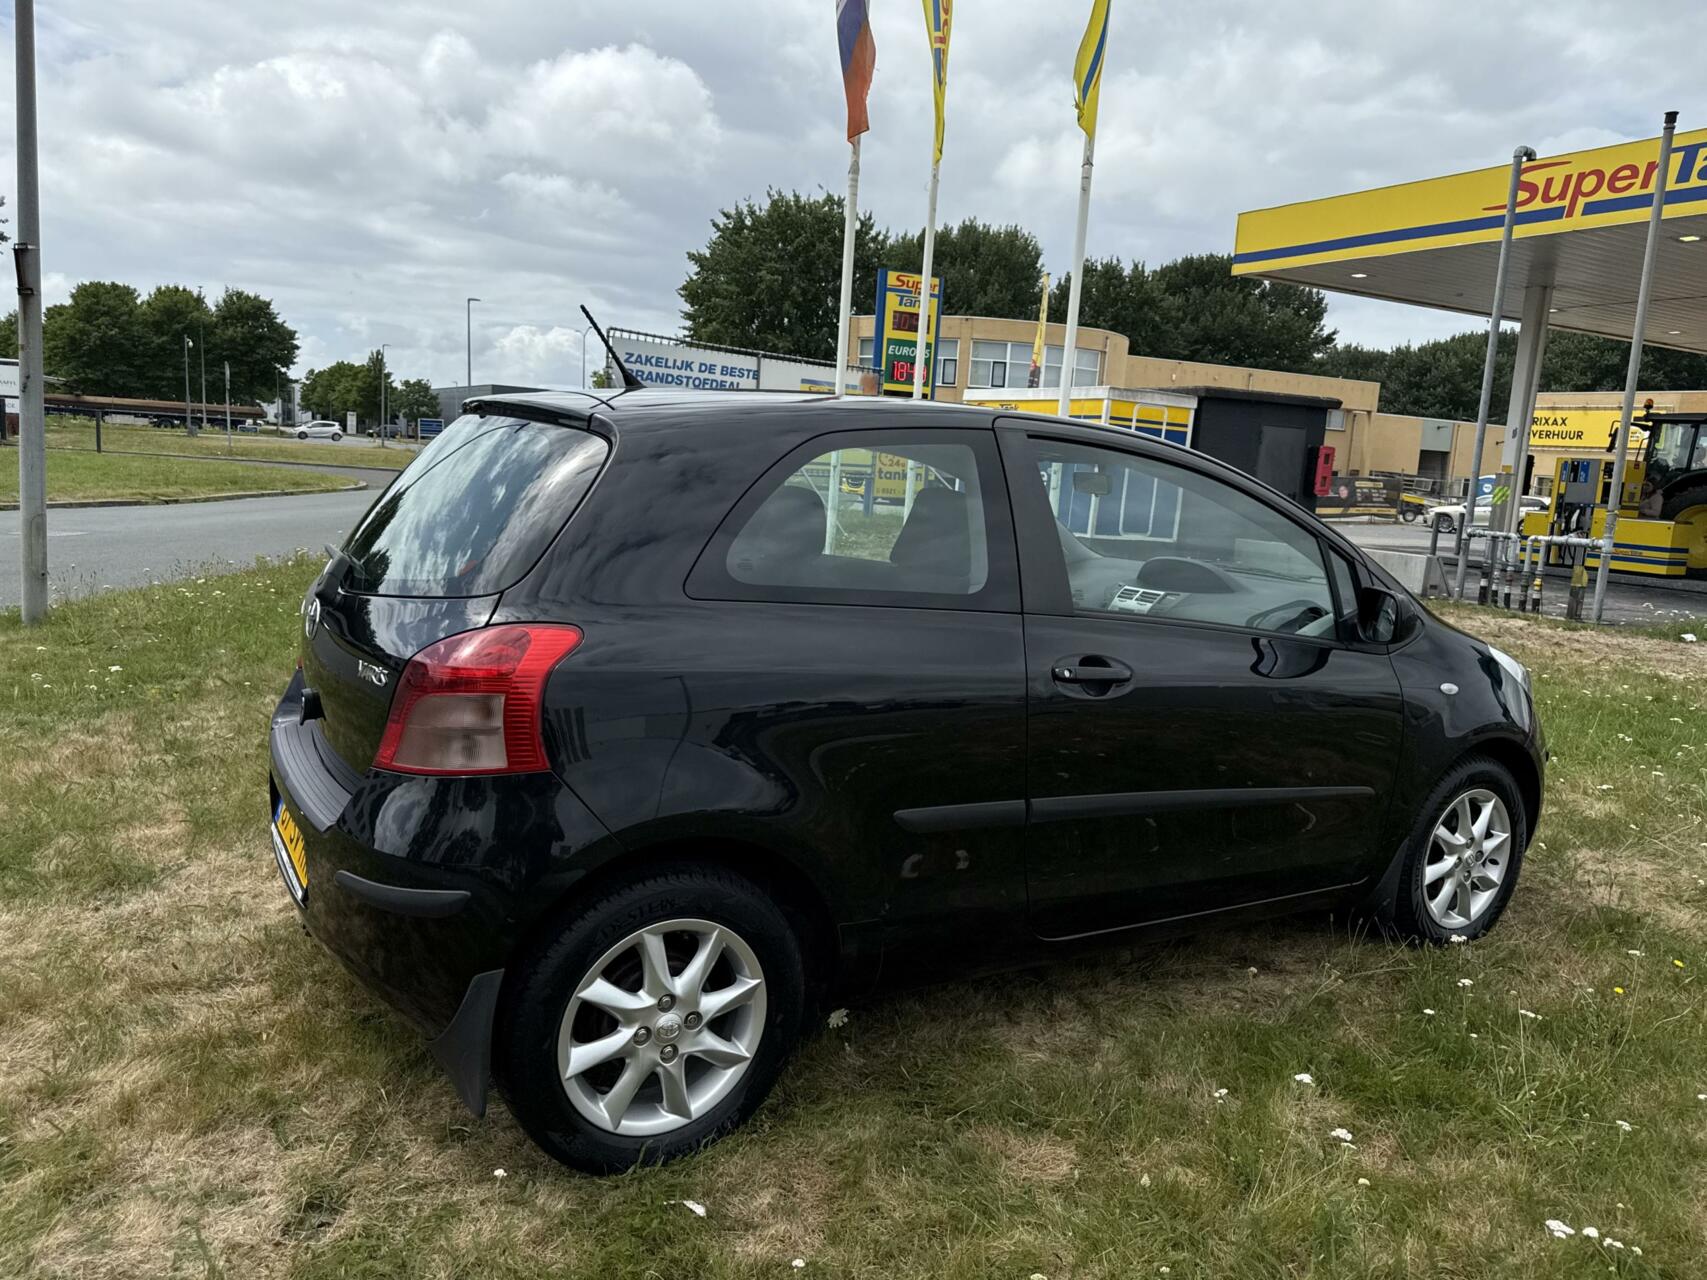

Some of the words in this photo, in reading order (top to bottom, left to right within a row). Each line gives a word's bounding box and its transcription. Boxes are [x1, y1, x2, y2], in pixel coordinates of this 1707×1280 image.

[1482, 161, 1658, 218] Super
[888, 274, 939, 296] Supr
[896, 294, 922, 309] Tan
[888, 345, 916, 356] EURO
[624, 352, 695, 372] ZAKELIJK
[698, 362, 717, 375] DE
[720, 365, 759, 380] BESTE
[1531, 430, 1584, 440] VERHUUR
[878, 467, 923, 482] tankn
